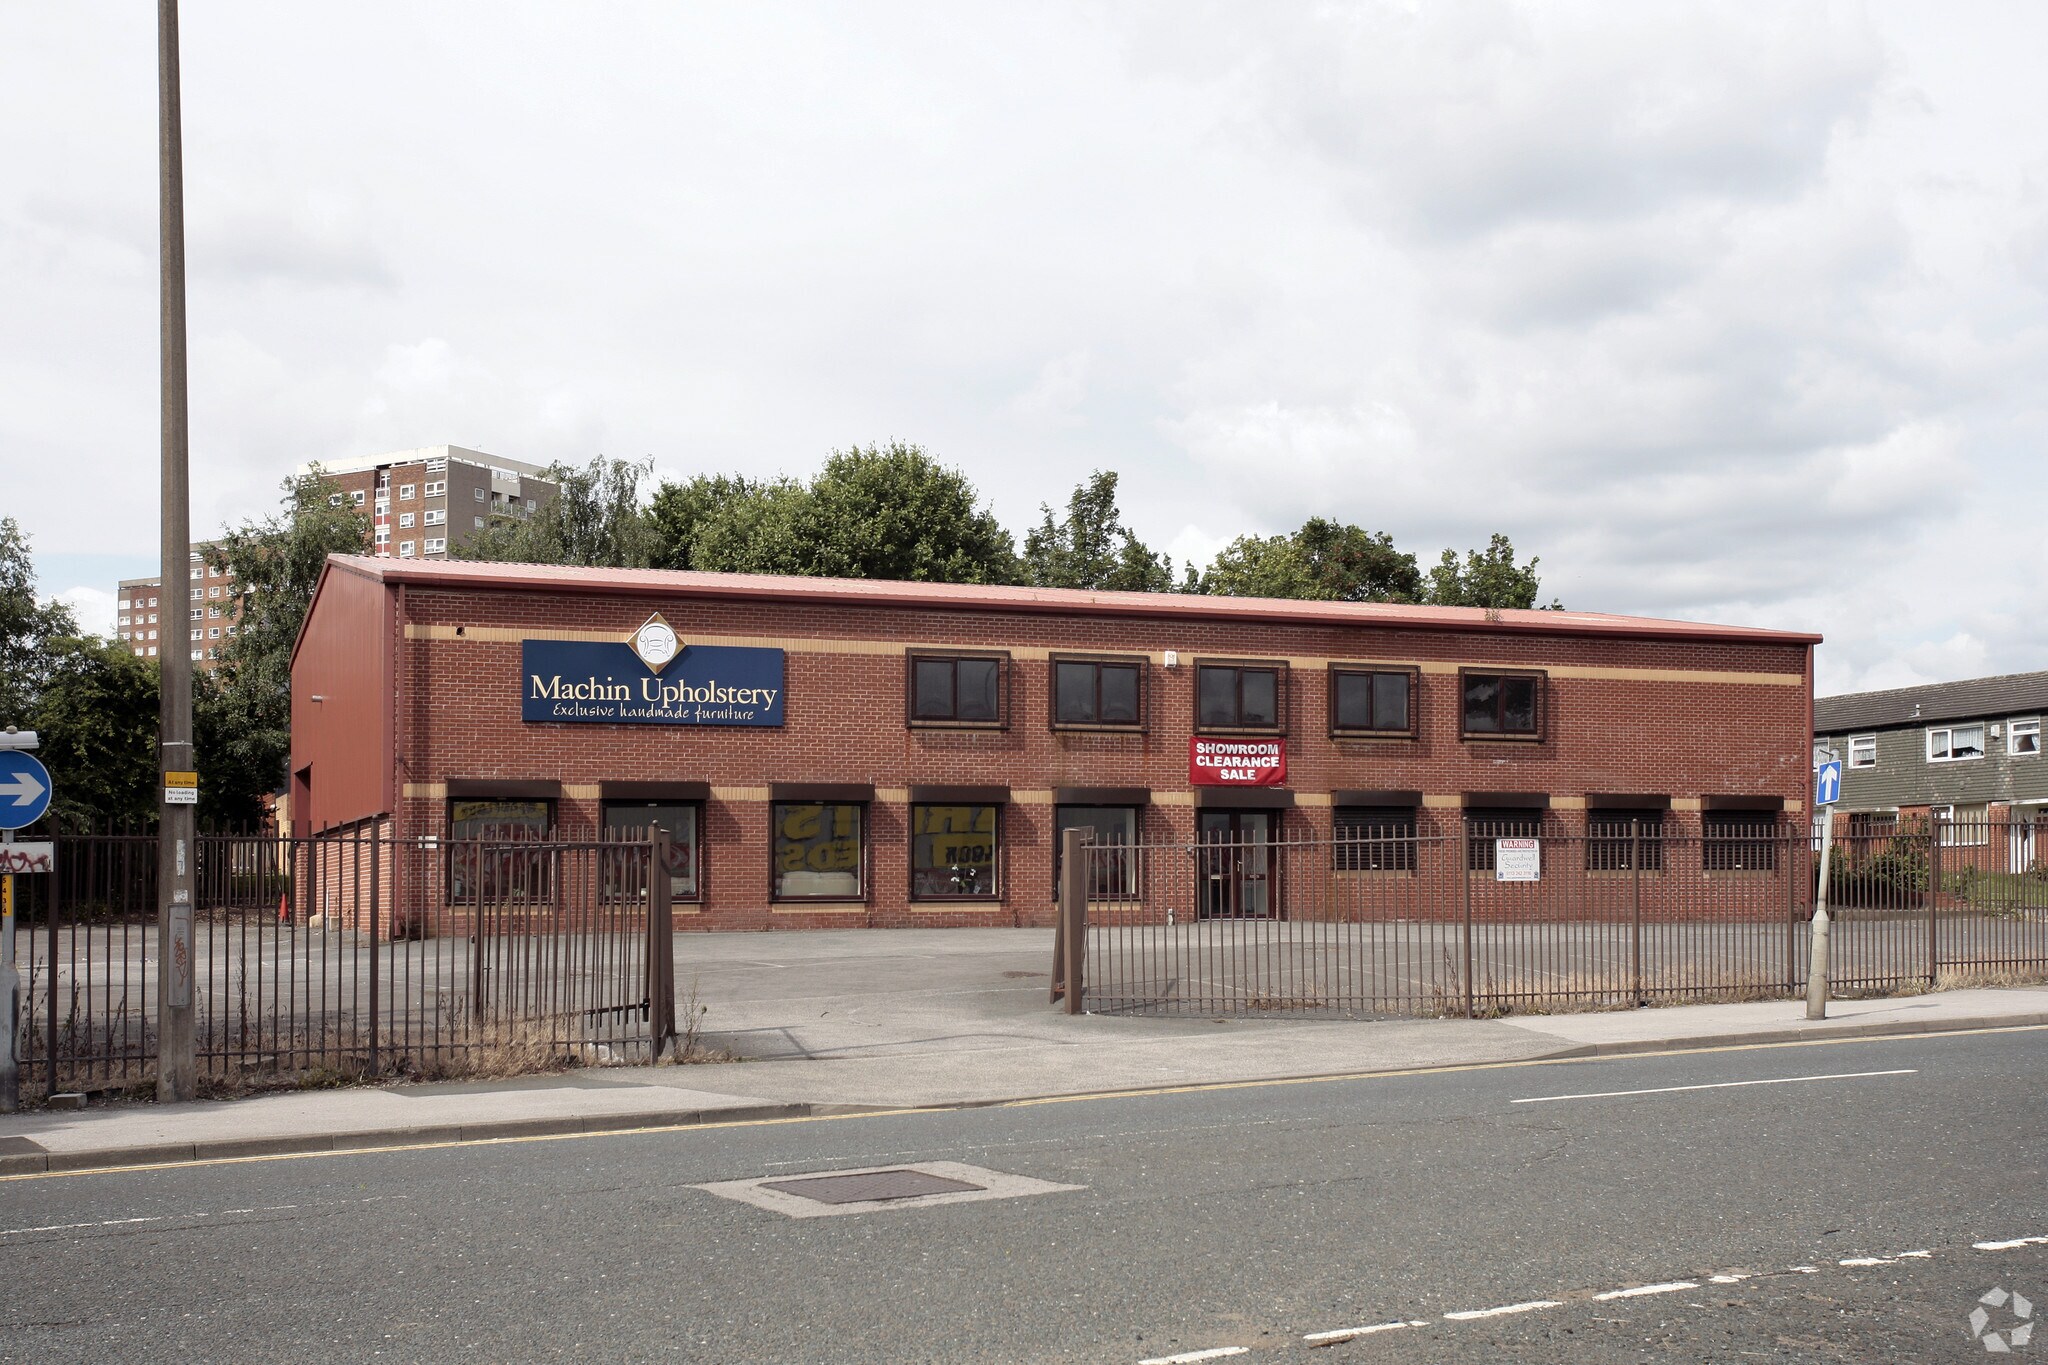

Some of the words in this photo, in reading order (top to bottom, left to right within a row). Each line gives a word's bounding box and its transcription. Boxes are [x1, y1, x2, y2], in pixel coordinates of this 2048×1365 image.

[530, 674, 632, 702] Machin
[640, 677, 778, 711] Upholstery
[552, 702, 615, 717] Exclusive
[619, 702, 690, 720] handmade
[694, 704, 755, 723] furniture
[1196, 742, 1279, 755] SHOWROOM
[1195, 755, 1280, 768] CLEARANCE
[1220, 768, 1256, 781] SALE
[1502, 840, 1534, 848] WARNING
[1504, 860, 1533, 870] Security
